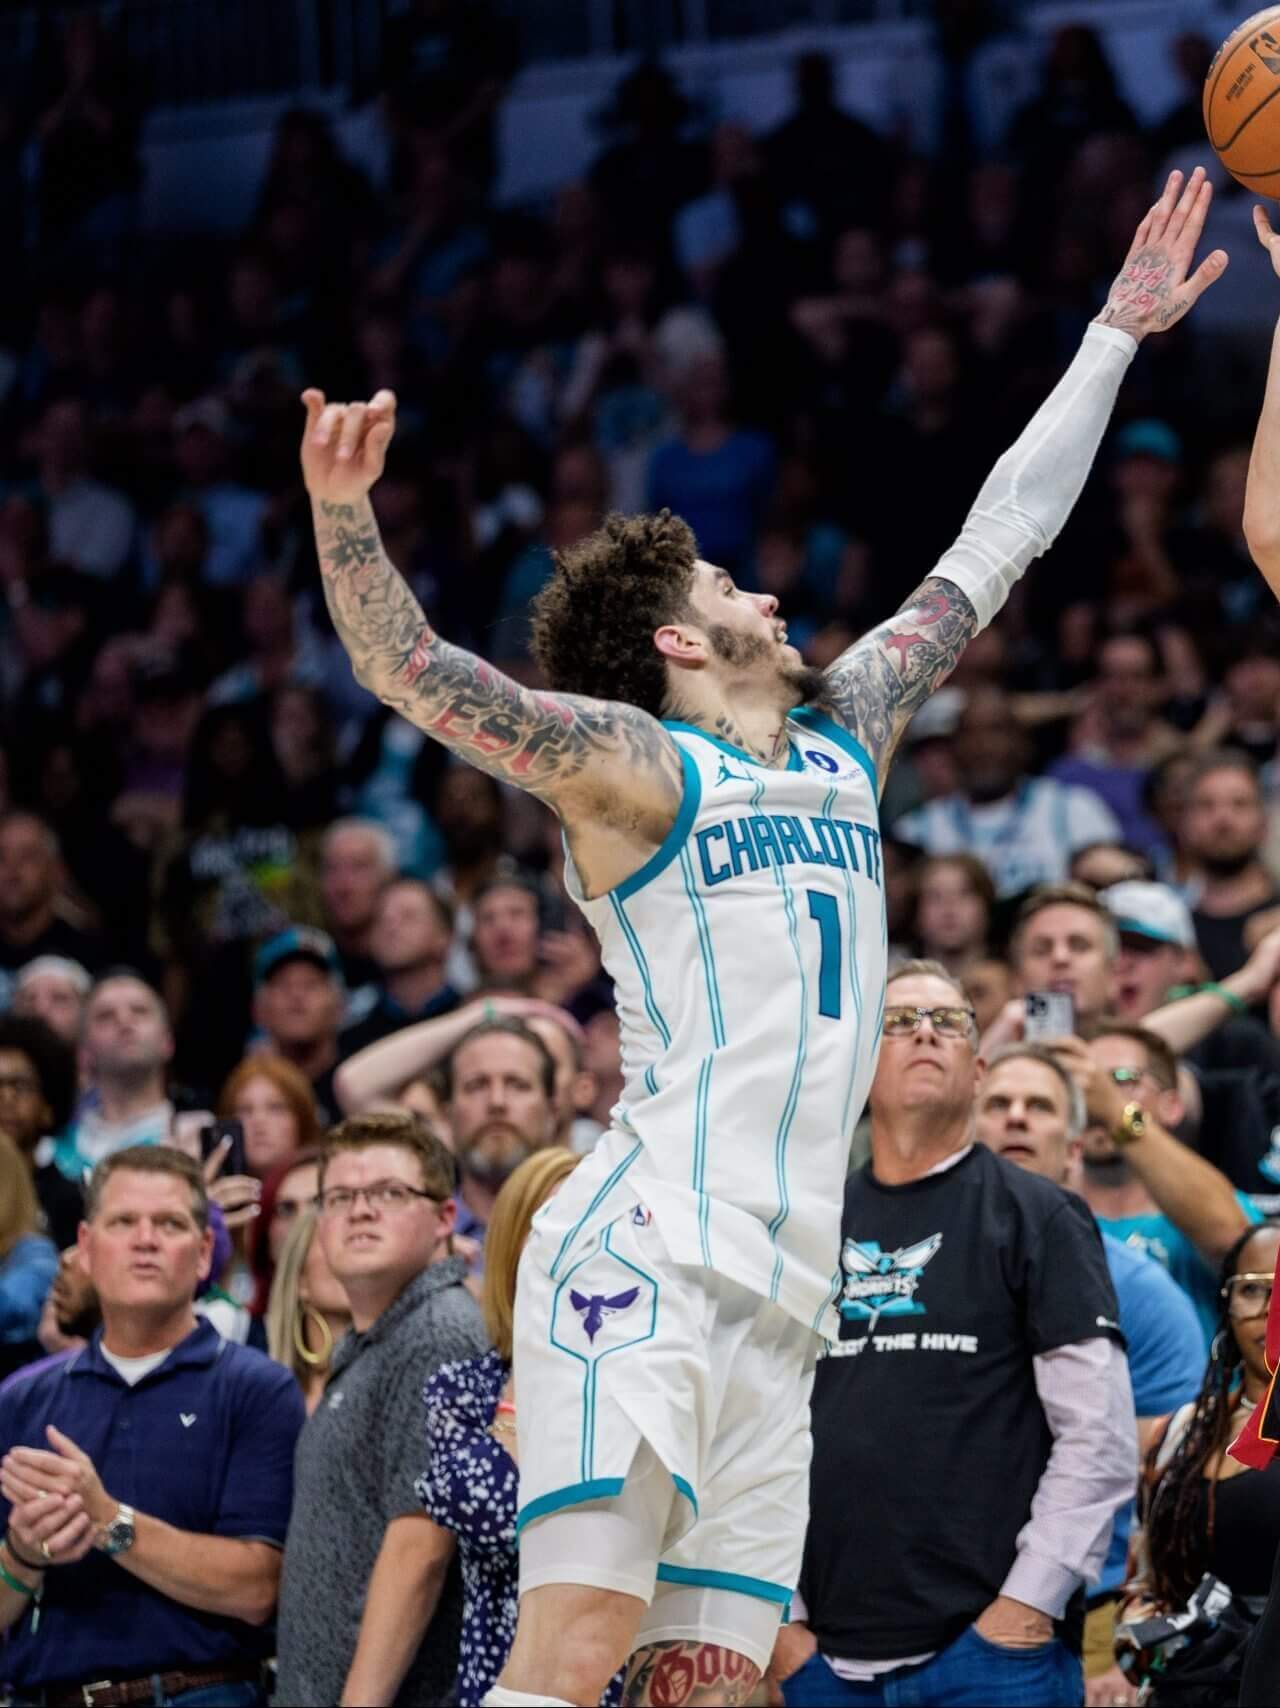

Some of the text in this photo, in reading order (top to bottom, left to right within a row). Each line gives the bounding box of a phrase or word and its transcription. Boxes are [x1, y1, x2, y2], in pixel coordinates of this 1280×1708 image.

[806, 888, 842, 1021] 1
[871, 1333, 917, 1352] THE
[920, 1333, 978, 1353] HIVE
